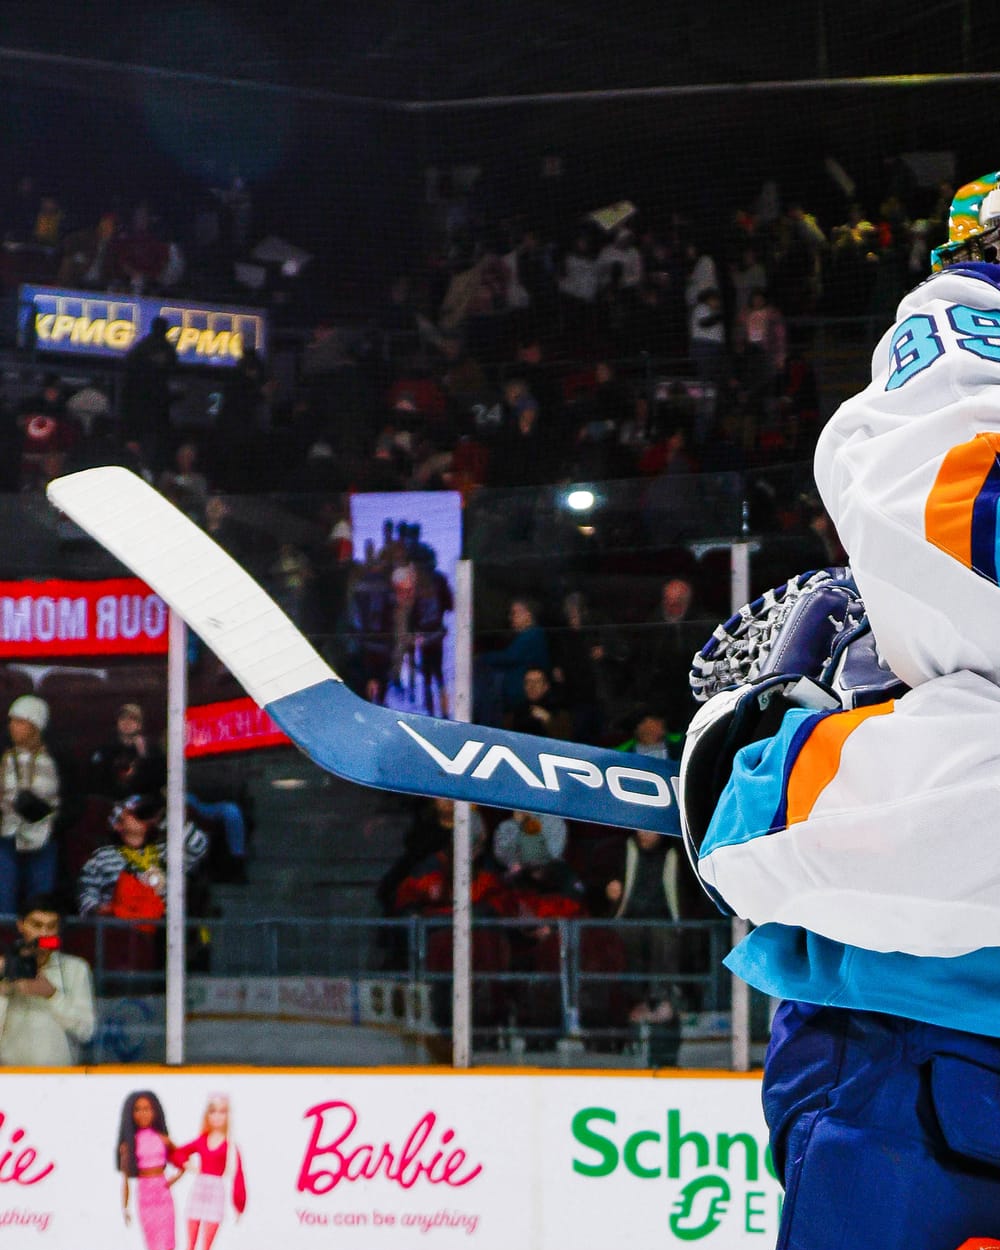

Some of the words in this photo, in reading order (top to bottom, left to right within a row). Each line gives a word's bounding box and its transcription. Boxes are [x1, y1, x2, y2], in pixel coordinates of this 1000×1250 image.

[397, 720, 681, 807] VAPO
[297, 1100, 483, 1195] Barbie
[296, 1210, 328, 1226] You
[333, 1213, 368, 1226] can
[372, 1210, 396, 1226] be
[400, 1209, 481, 1234] anything
[745, 1192, 784, 1233] E
